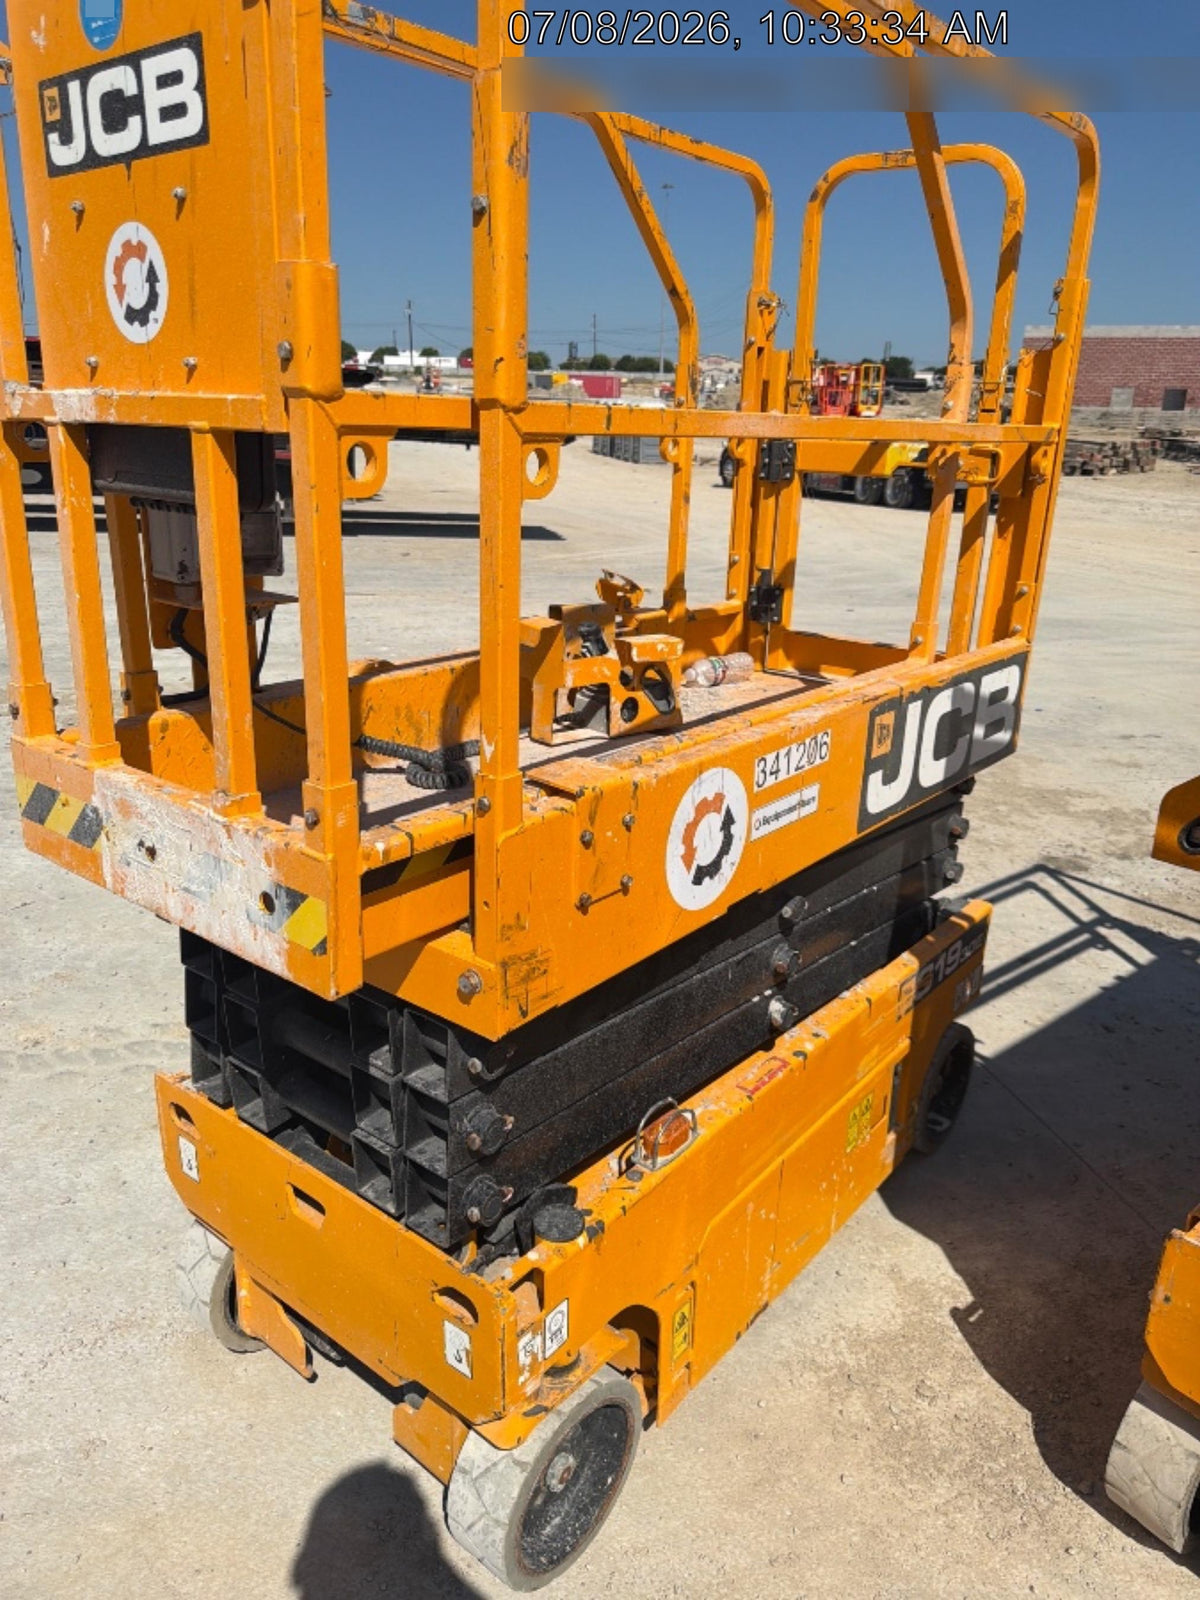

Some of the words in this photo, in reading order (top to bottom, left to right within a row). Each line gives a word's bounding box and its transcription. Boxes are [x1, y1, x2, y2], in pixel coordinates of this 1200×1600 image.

[47, 47, 204, 167] JCB
[755, 731, 830, 788] 341206
[866, 664, 1022, 816] JCB
